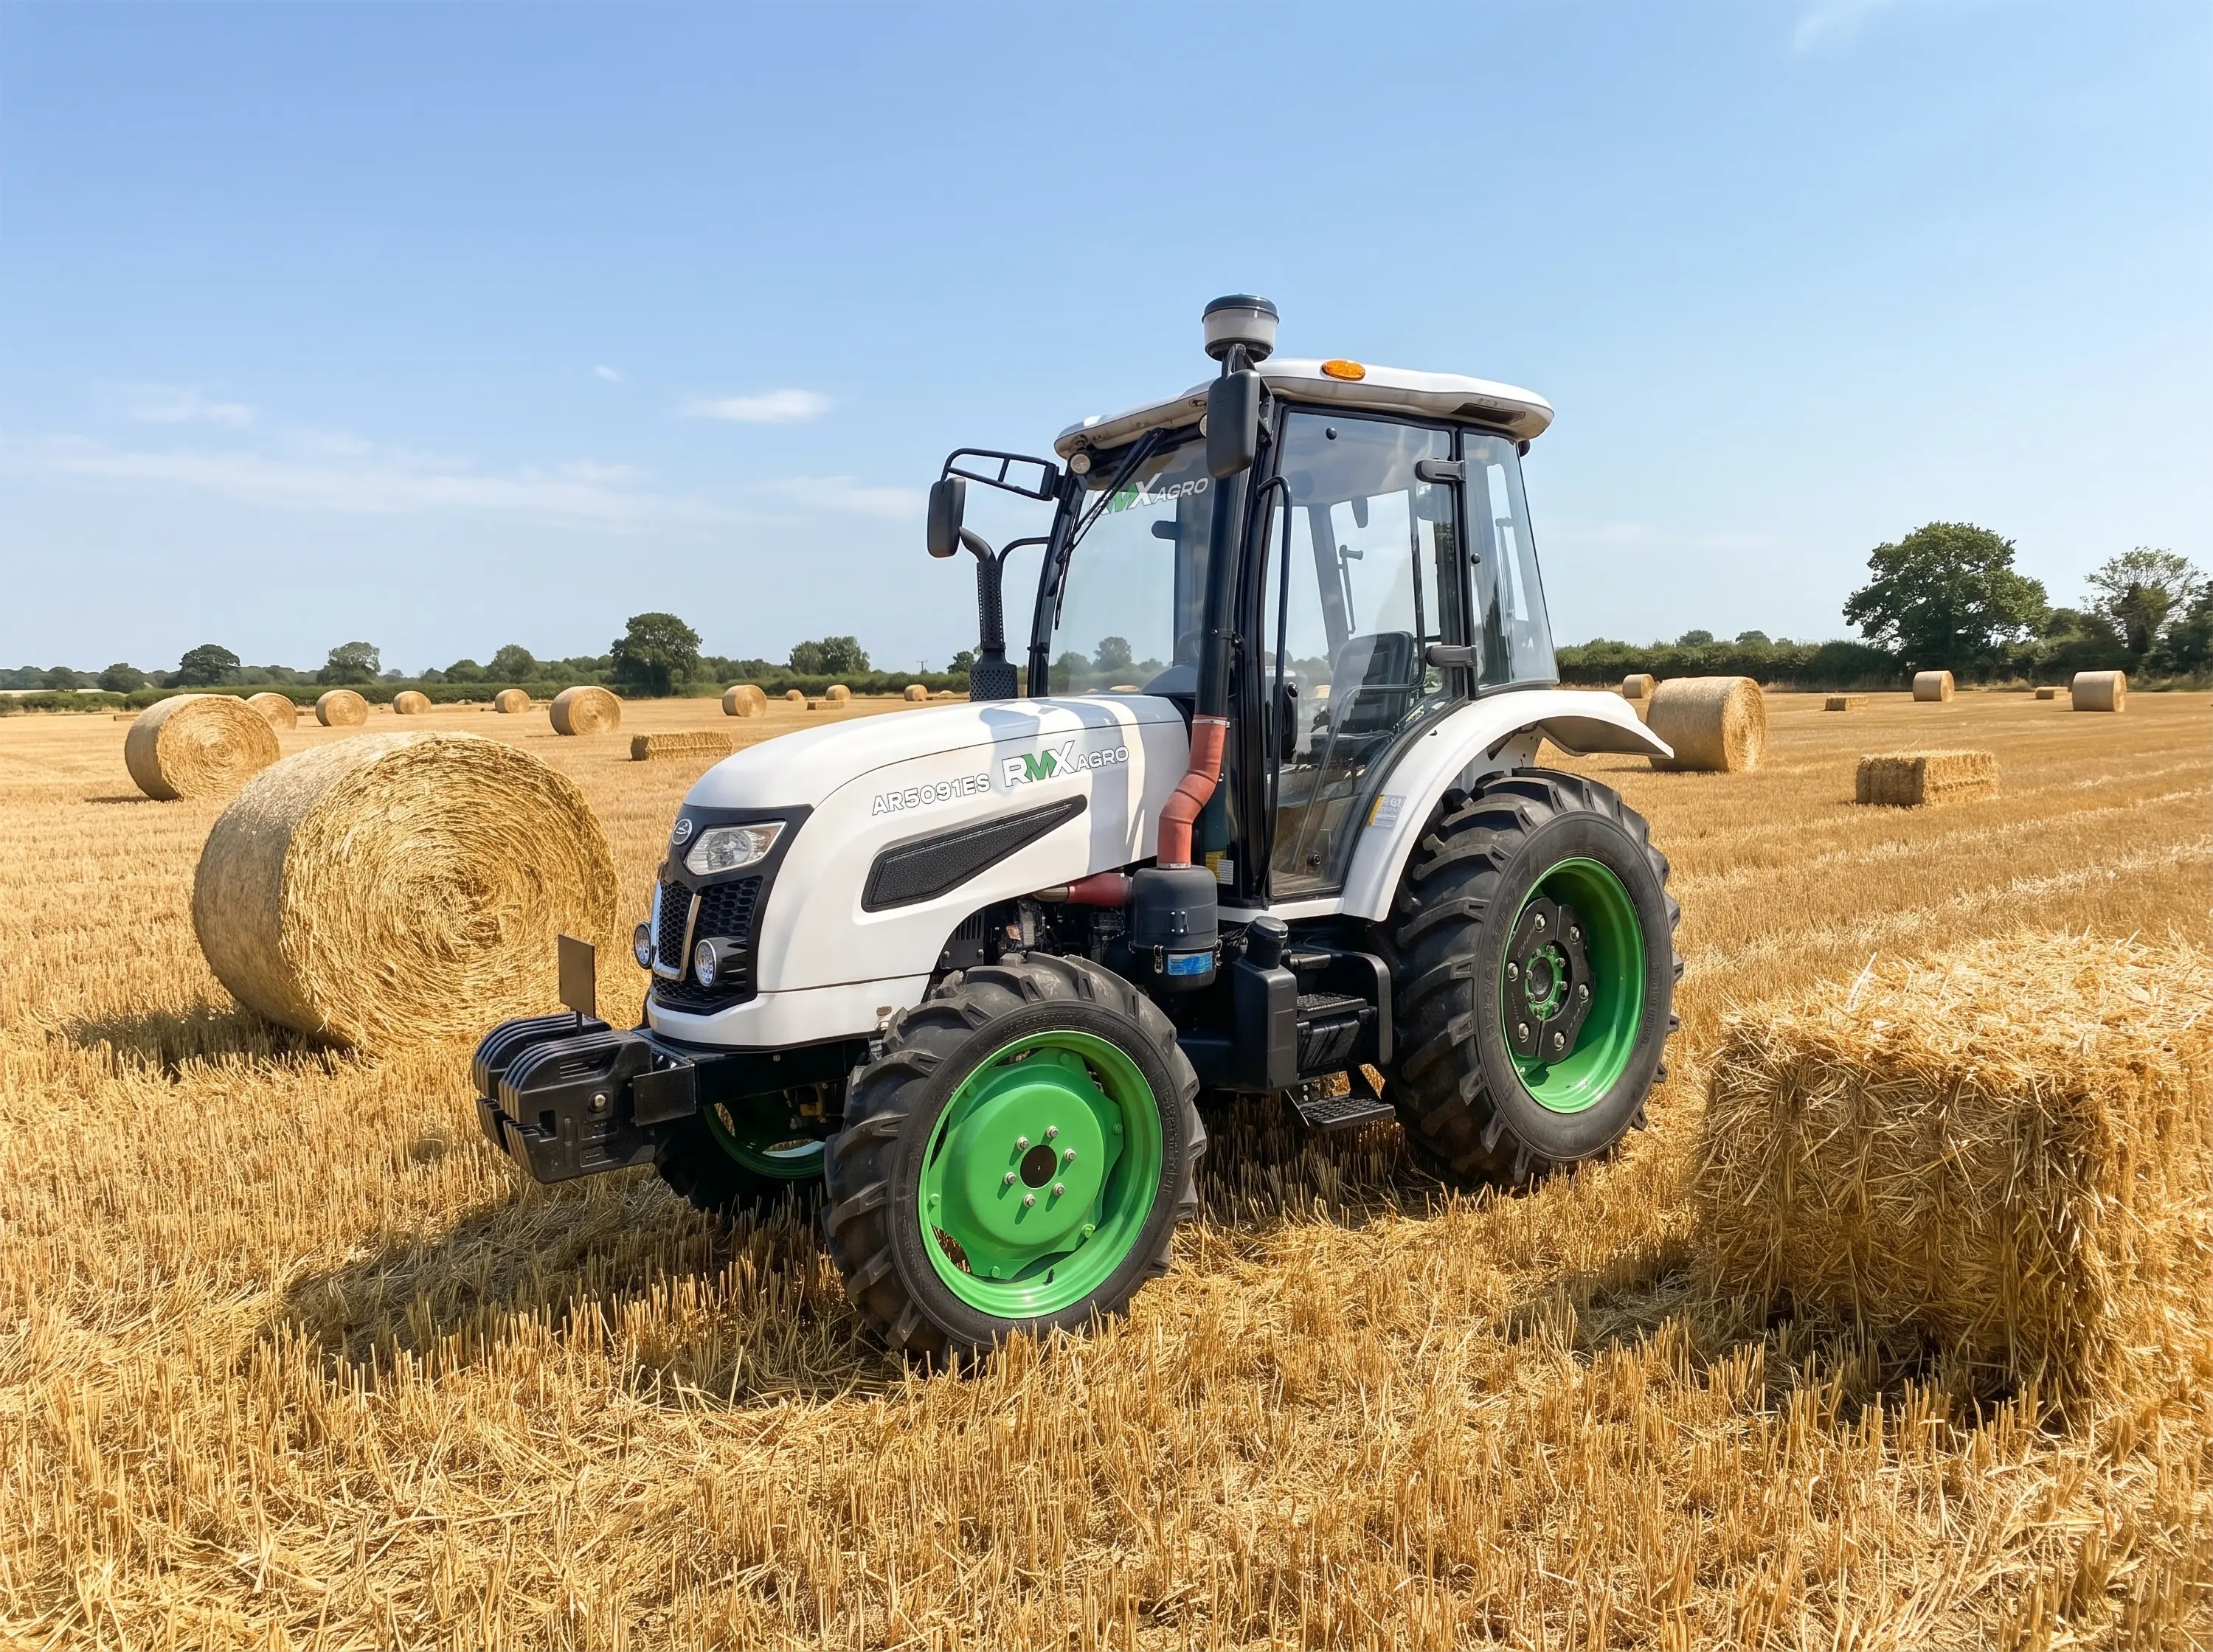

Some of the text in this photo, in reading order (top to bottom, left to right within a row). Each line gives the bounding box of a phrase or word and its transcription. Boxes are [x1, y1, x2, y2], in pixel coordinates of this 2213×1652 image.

[1151, 478, 1208, 504] AGRO
[872, 740, 1129, 816] AR5091ES RMX AGRO
